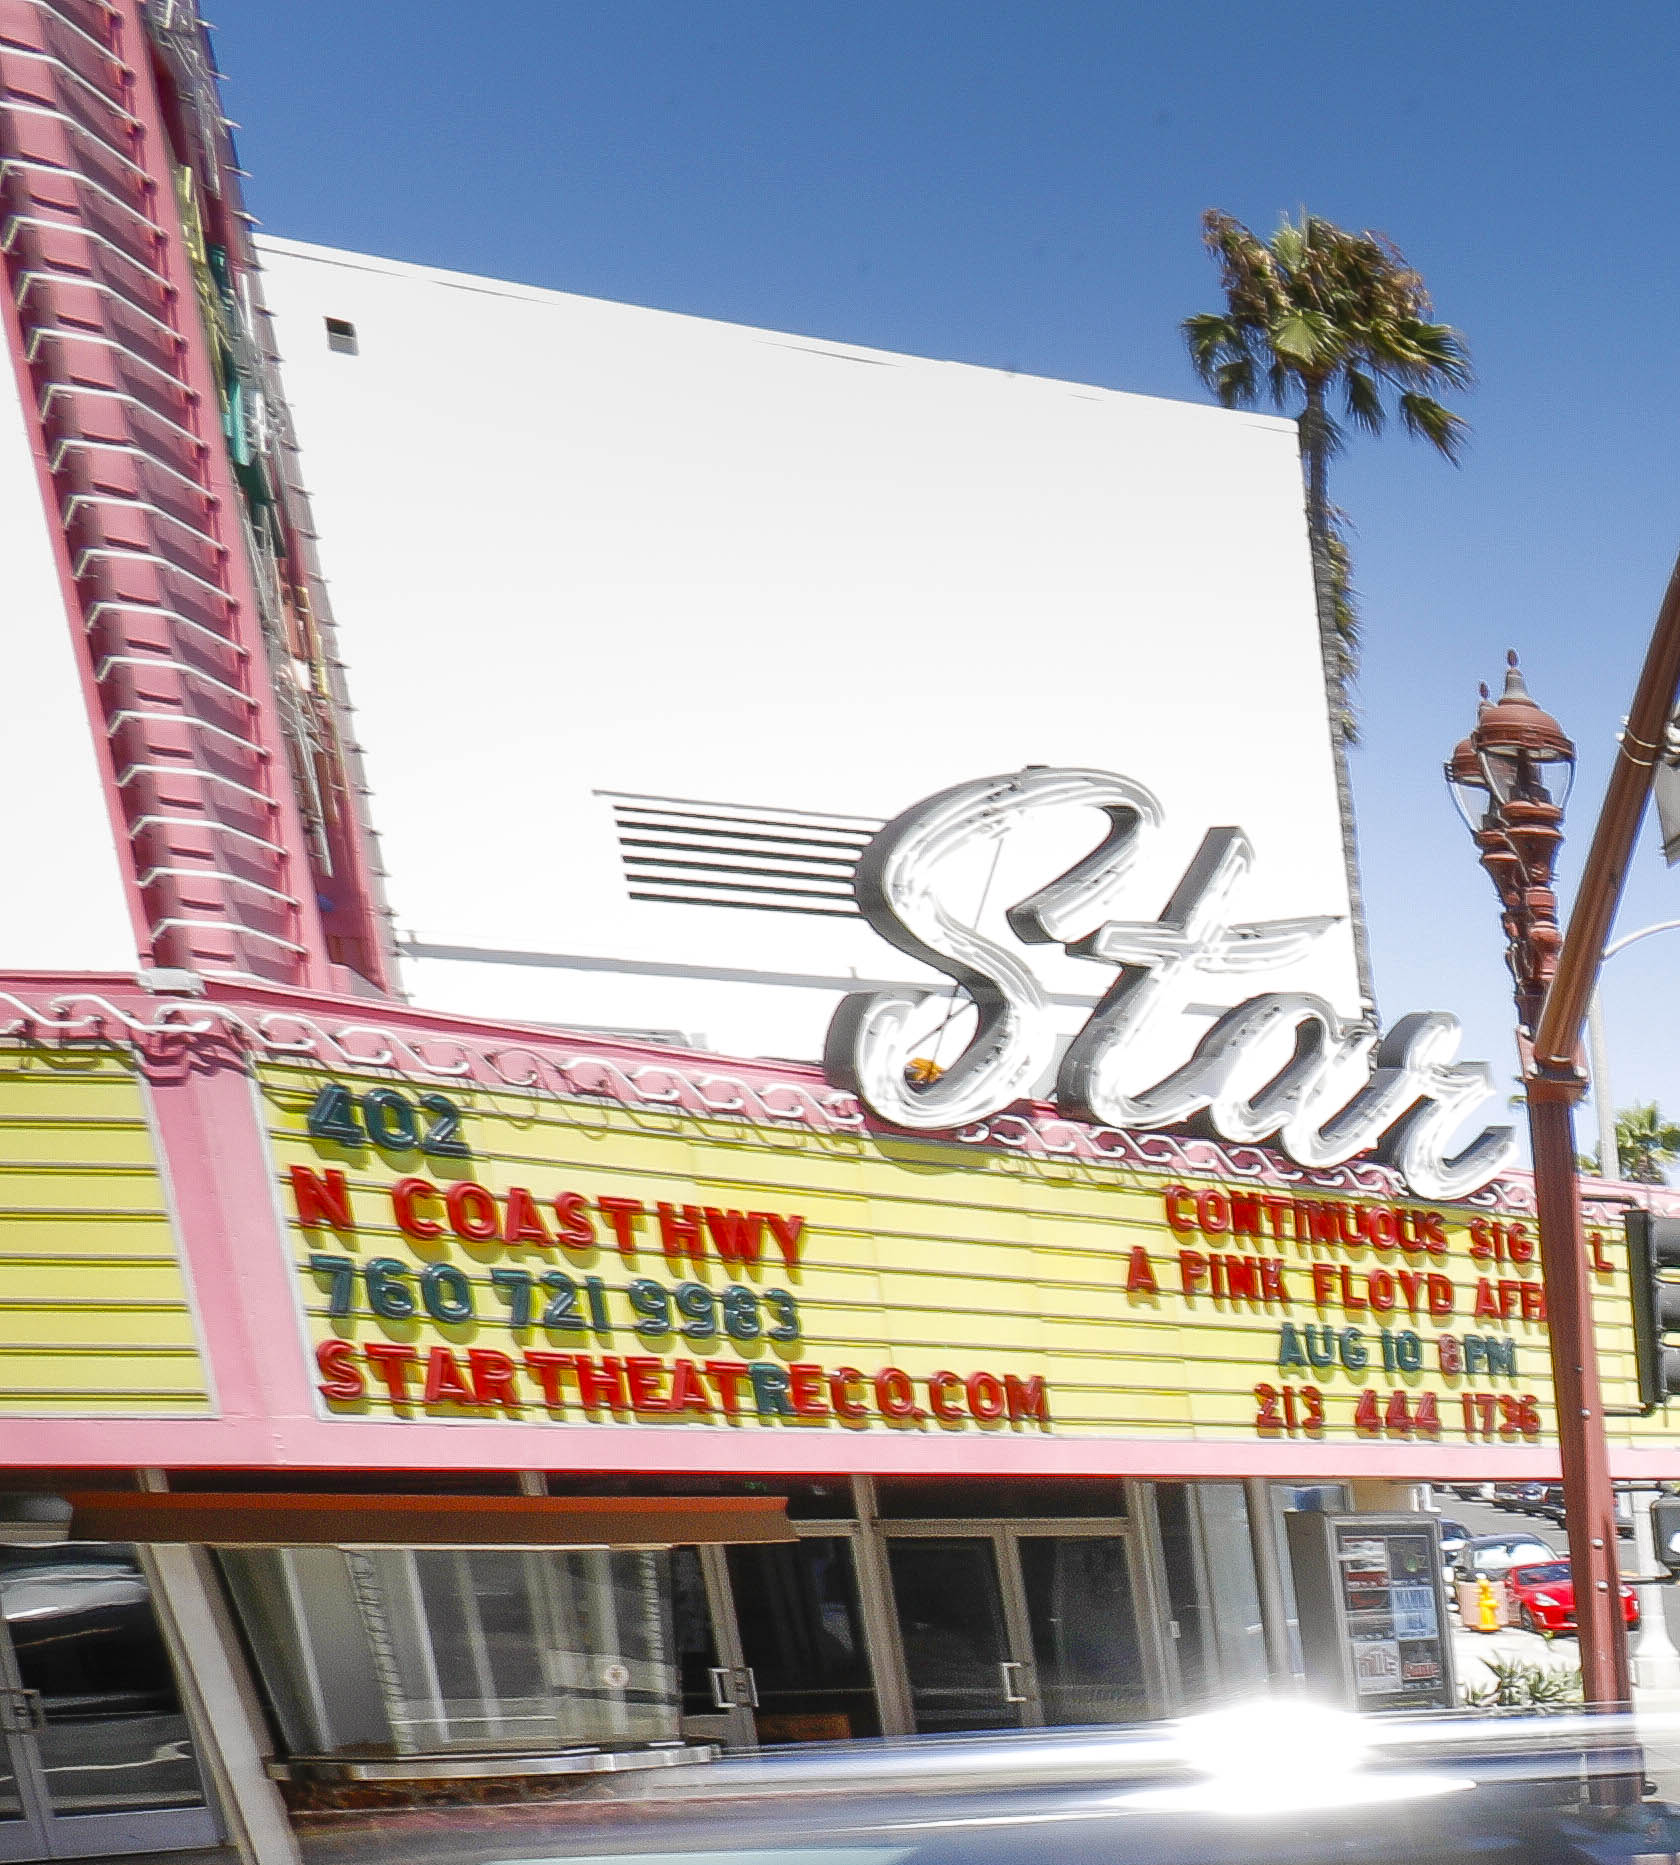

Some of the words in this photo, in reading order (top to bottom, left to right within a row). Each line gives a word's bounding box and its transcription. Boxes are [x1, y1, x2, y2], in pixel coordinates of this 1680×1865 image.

[823, 765, 1515, 1201] Star
[308, 1083, 471, 1157] 402
[290, 1164, 355, 1231] N
[1163, 1184, 1447, 1255] CONTINUOUS
[309, 1253, 473, 1323] 760
[490, 1267, 611, 1333] 721
[629, 1278, 802, 1342] 9983
[1125, 1246, 1159, 1294] A
[1179, 1249, 1290, 1304] PINK
[1312, 1262, 1457, 1316] FLOYD
[1279, 1321, 1369, 1371] AUG
[1382, 1328, 1423, 1371] 10
[1438, 1333, 1518, 1377] 8PM
[1253, 1383, 1325, 1430] 213
[1354, 1388, 1441, 1434] 444
[1460, 1392, 1542, 1435] 1736
